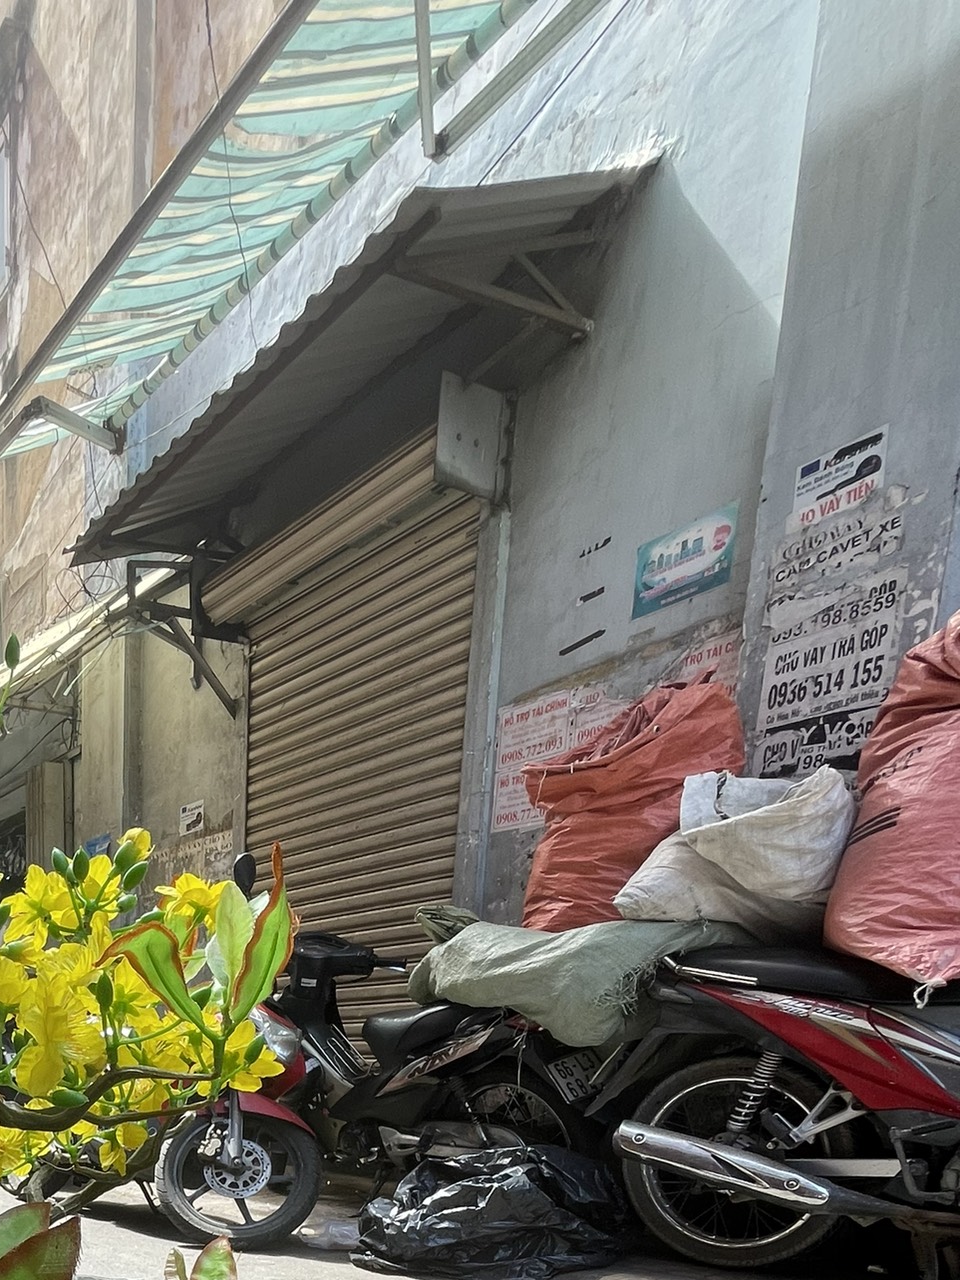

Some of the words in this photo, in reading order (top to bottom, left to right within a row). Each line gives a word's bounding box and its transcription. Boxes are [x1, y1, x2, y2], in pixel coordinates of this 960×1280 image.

[819, 494, 843, 517] VAY
[816, 528, 874, 564] CAVET
[878, 515, 902, 536] XE
[803, 645, 827, 668] VAY
[860, 620, 889, 652] GÓP
[812, 668, 845, 698] 514
[850, 655, 885, 689] 155
[501, 736, 564, 765] 0908.772.093
